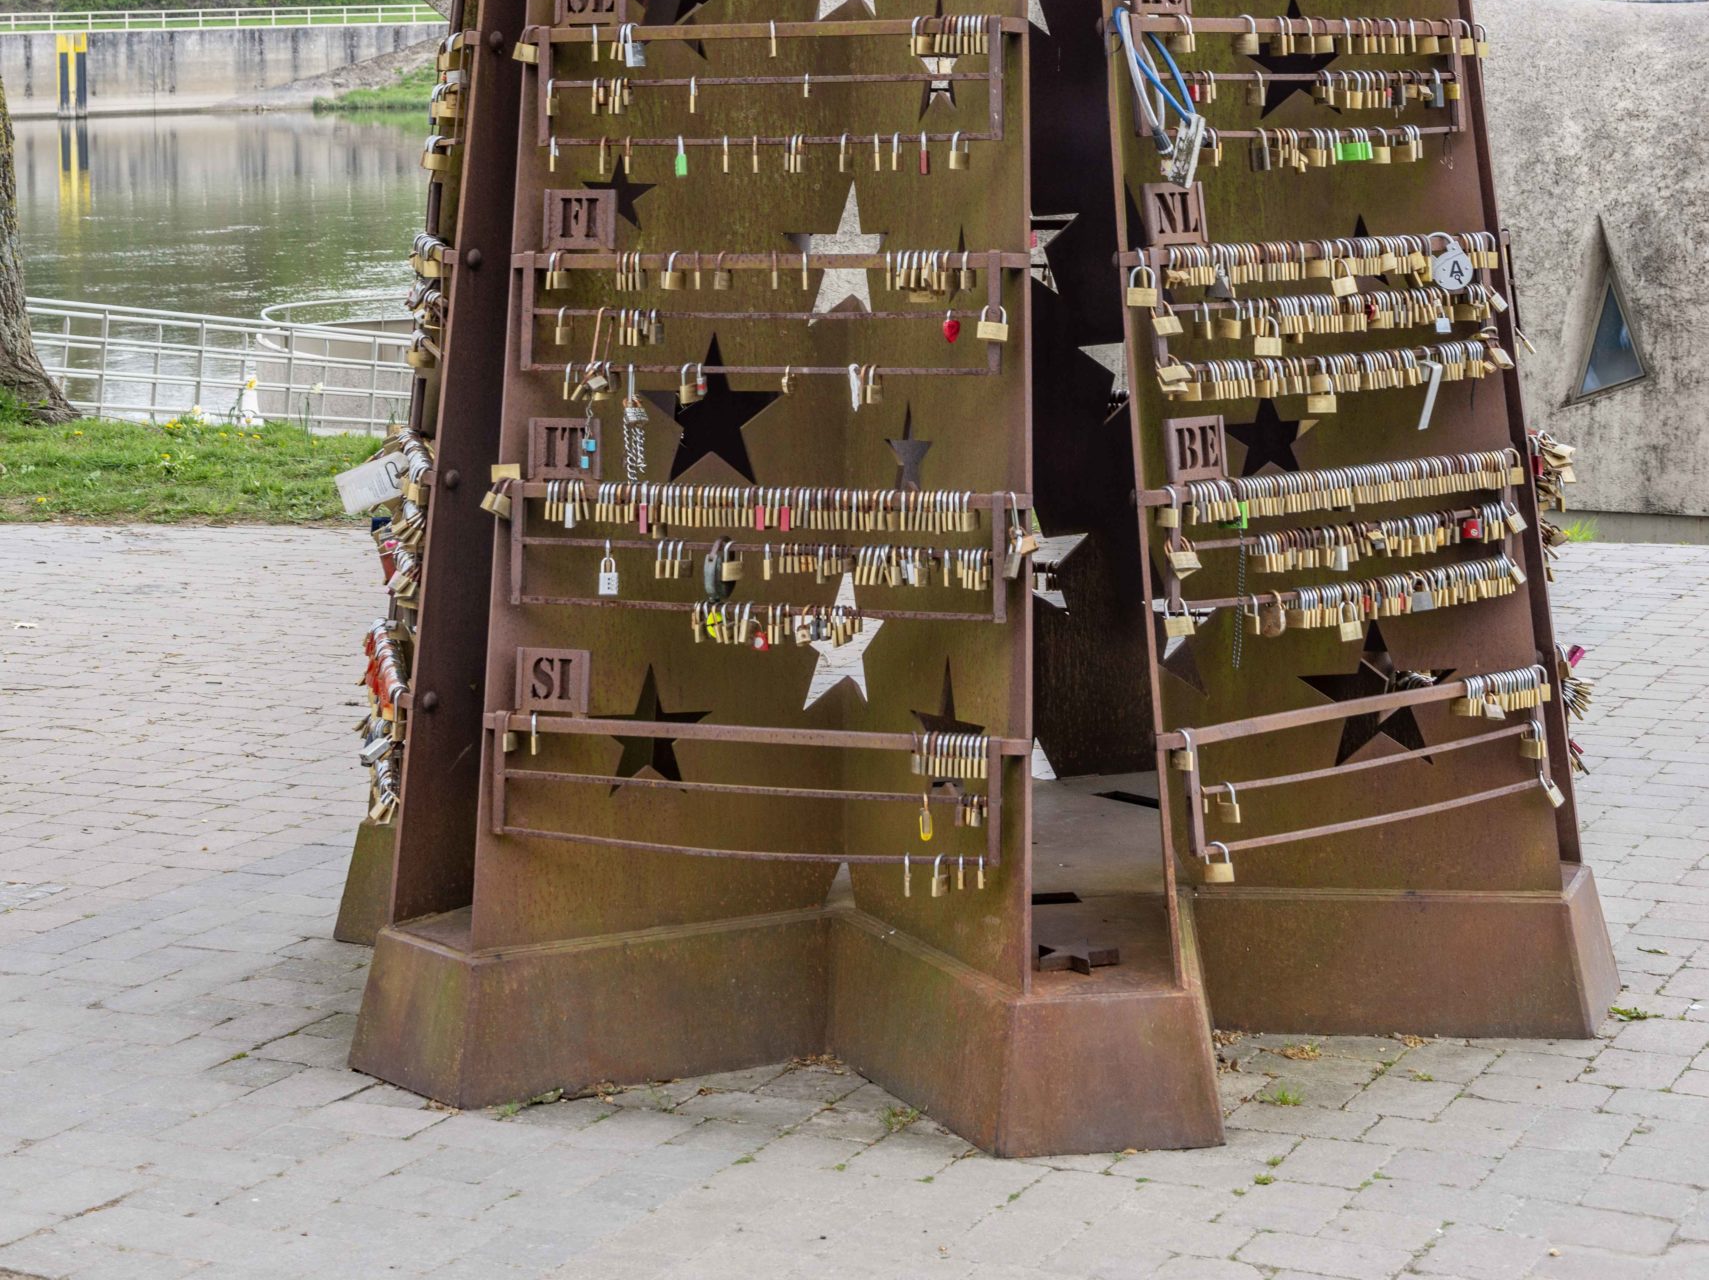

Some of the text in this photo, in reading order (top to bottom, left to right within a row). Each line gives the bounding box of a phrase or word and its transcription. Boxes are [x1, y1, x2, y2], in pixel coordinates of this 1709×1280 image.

[560, 197, 600, 238] FI
[1155, 192, 1199, 233] NL
[545, 426, 588, 468] IT
[1175, 425, 1219, 470] BE
[532, 657, 572, 700] SI
